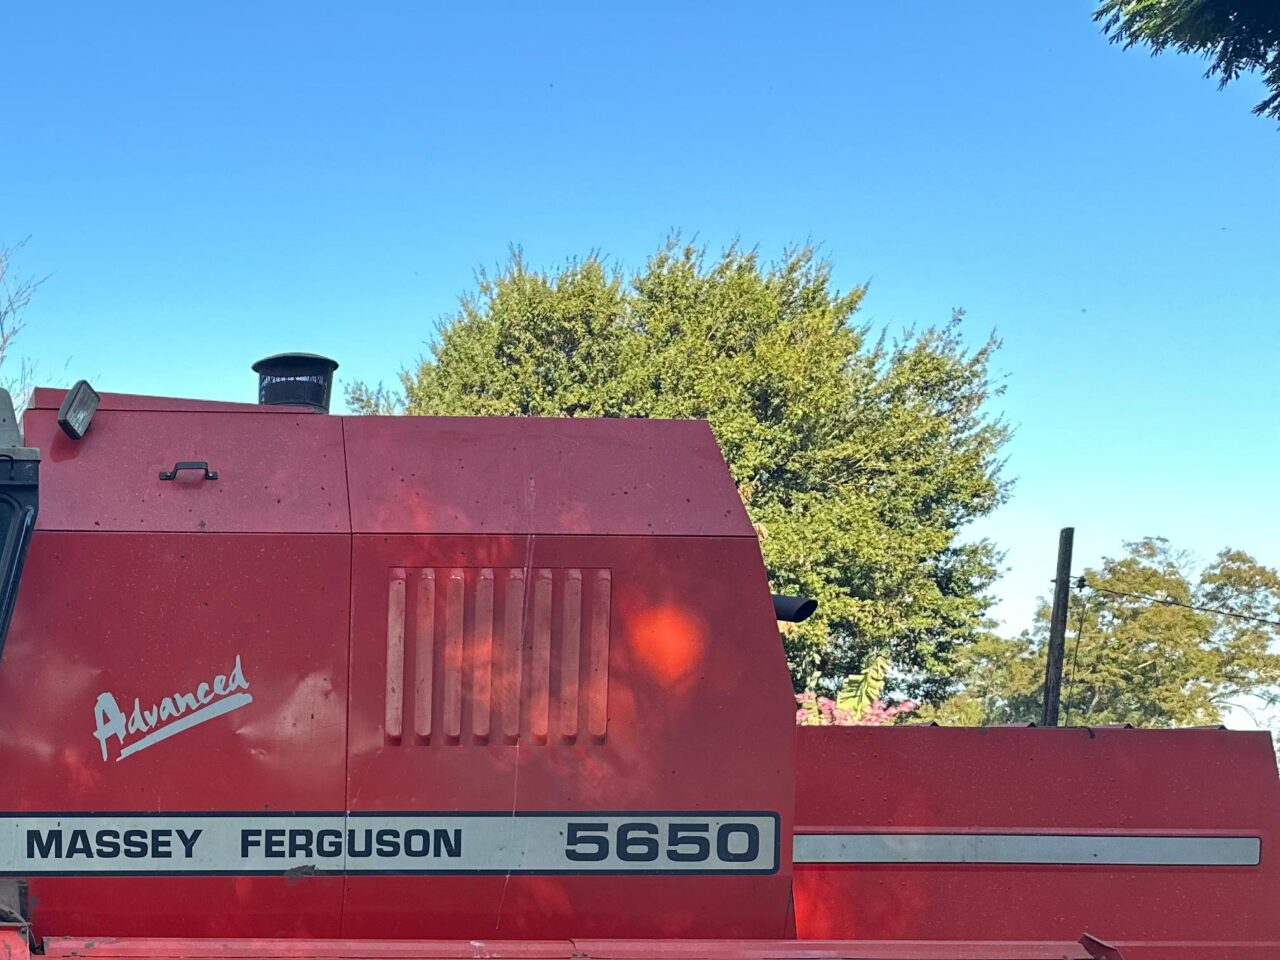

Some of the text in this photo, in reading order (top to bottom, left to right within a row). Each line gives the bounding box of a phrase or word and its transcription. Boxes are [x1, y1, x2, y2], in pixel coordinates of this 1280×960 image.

[93, 654, 252, 762] Advanced
[26, 822, 760, 862] MASSEY FERGUSON 5650
